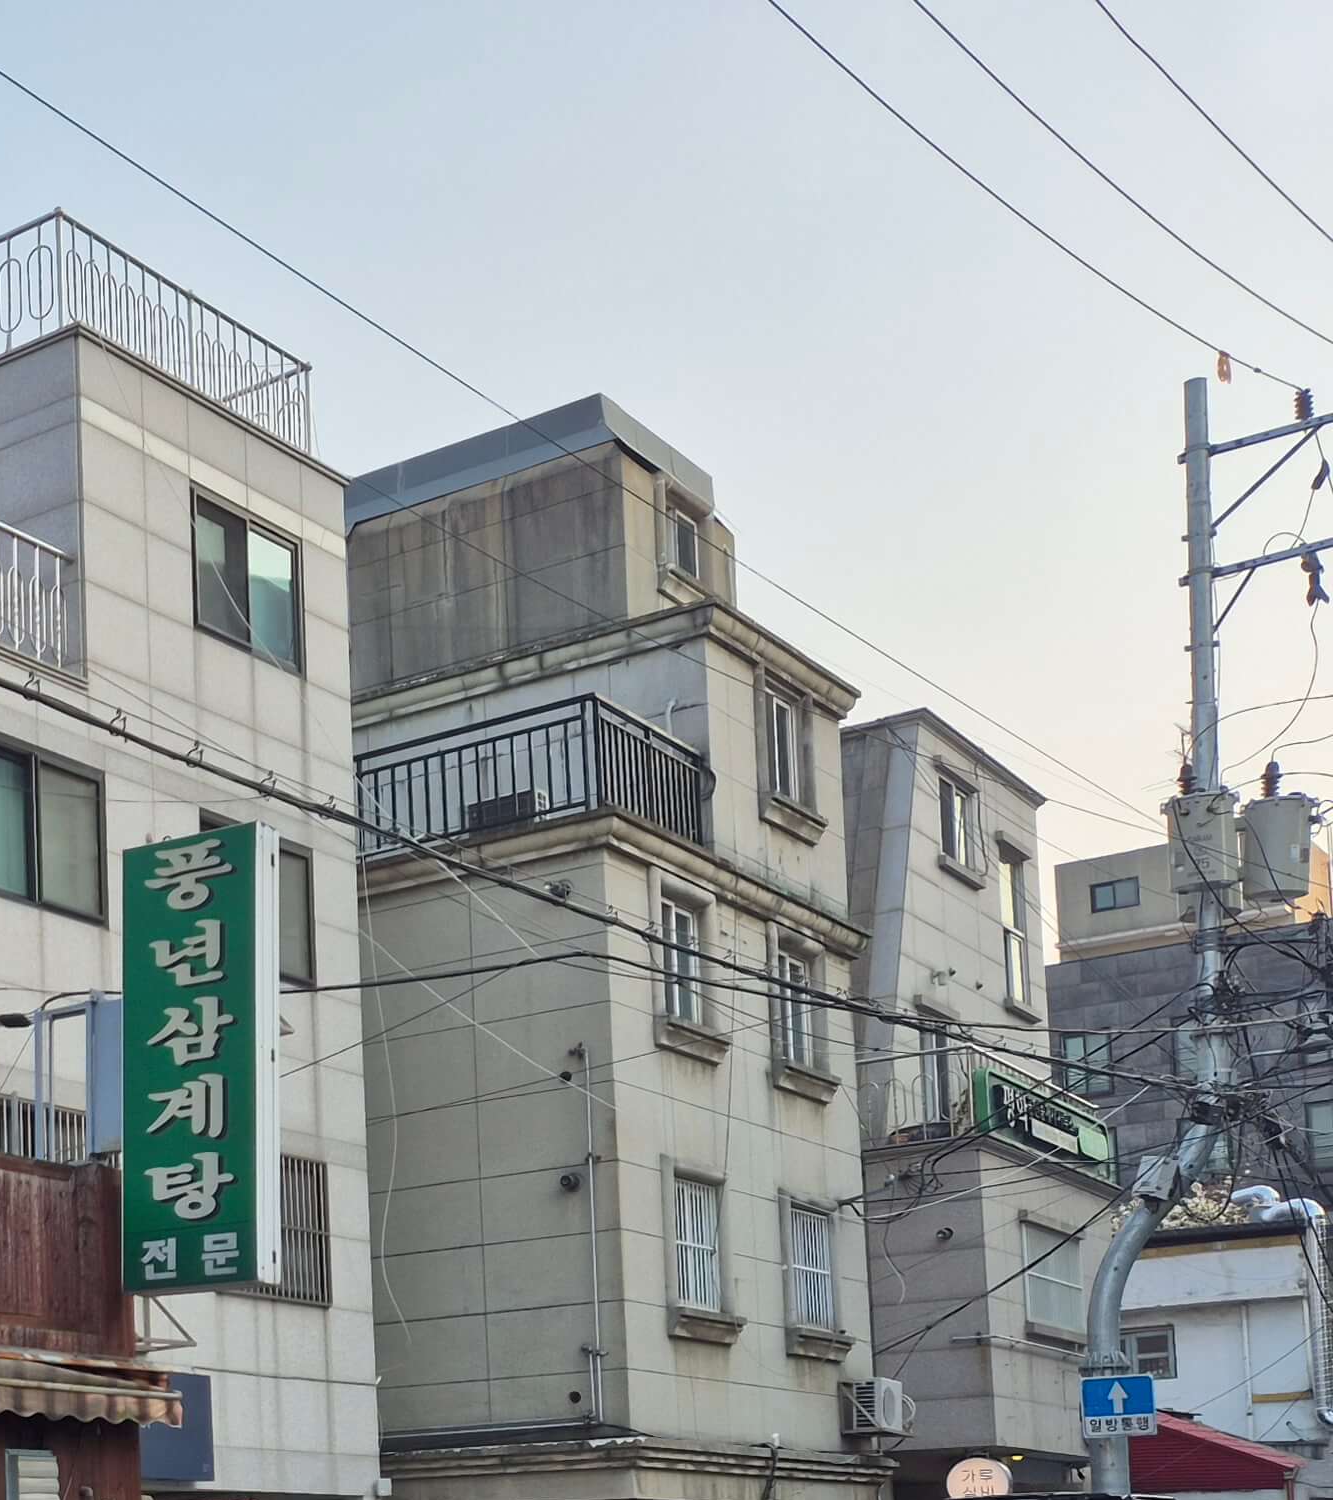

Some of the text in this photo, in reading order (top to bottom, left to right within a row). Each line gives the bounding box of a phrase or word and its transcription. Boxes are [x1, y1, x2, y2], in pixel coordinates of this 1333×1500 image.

[144, 838, 235, 1221] 풍년삼계탕
[140, 1232, 240, 1281] 전문
[1090, 1415, 1149, 1433] 일방통행
